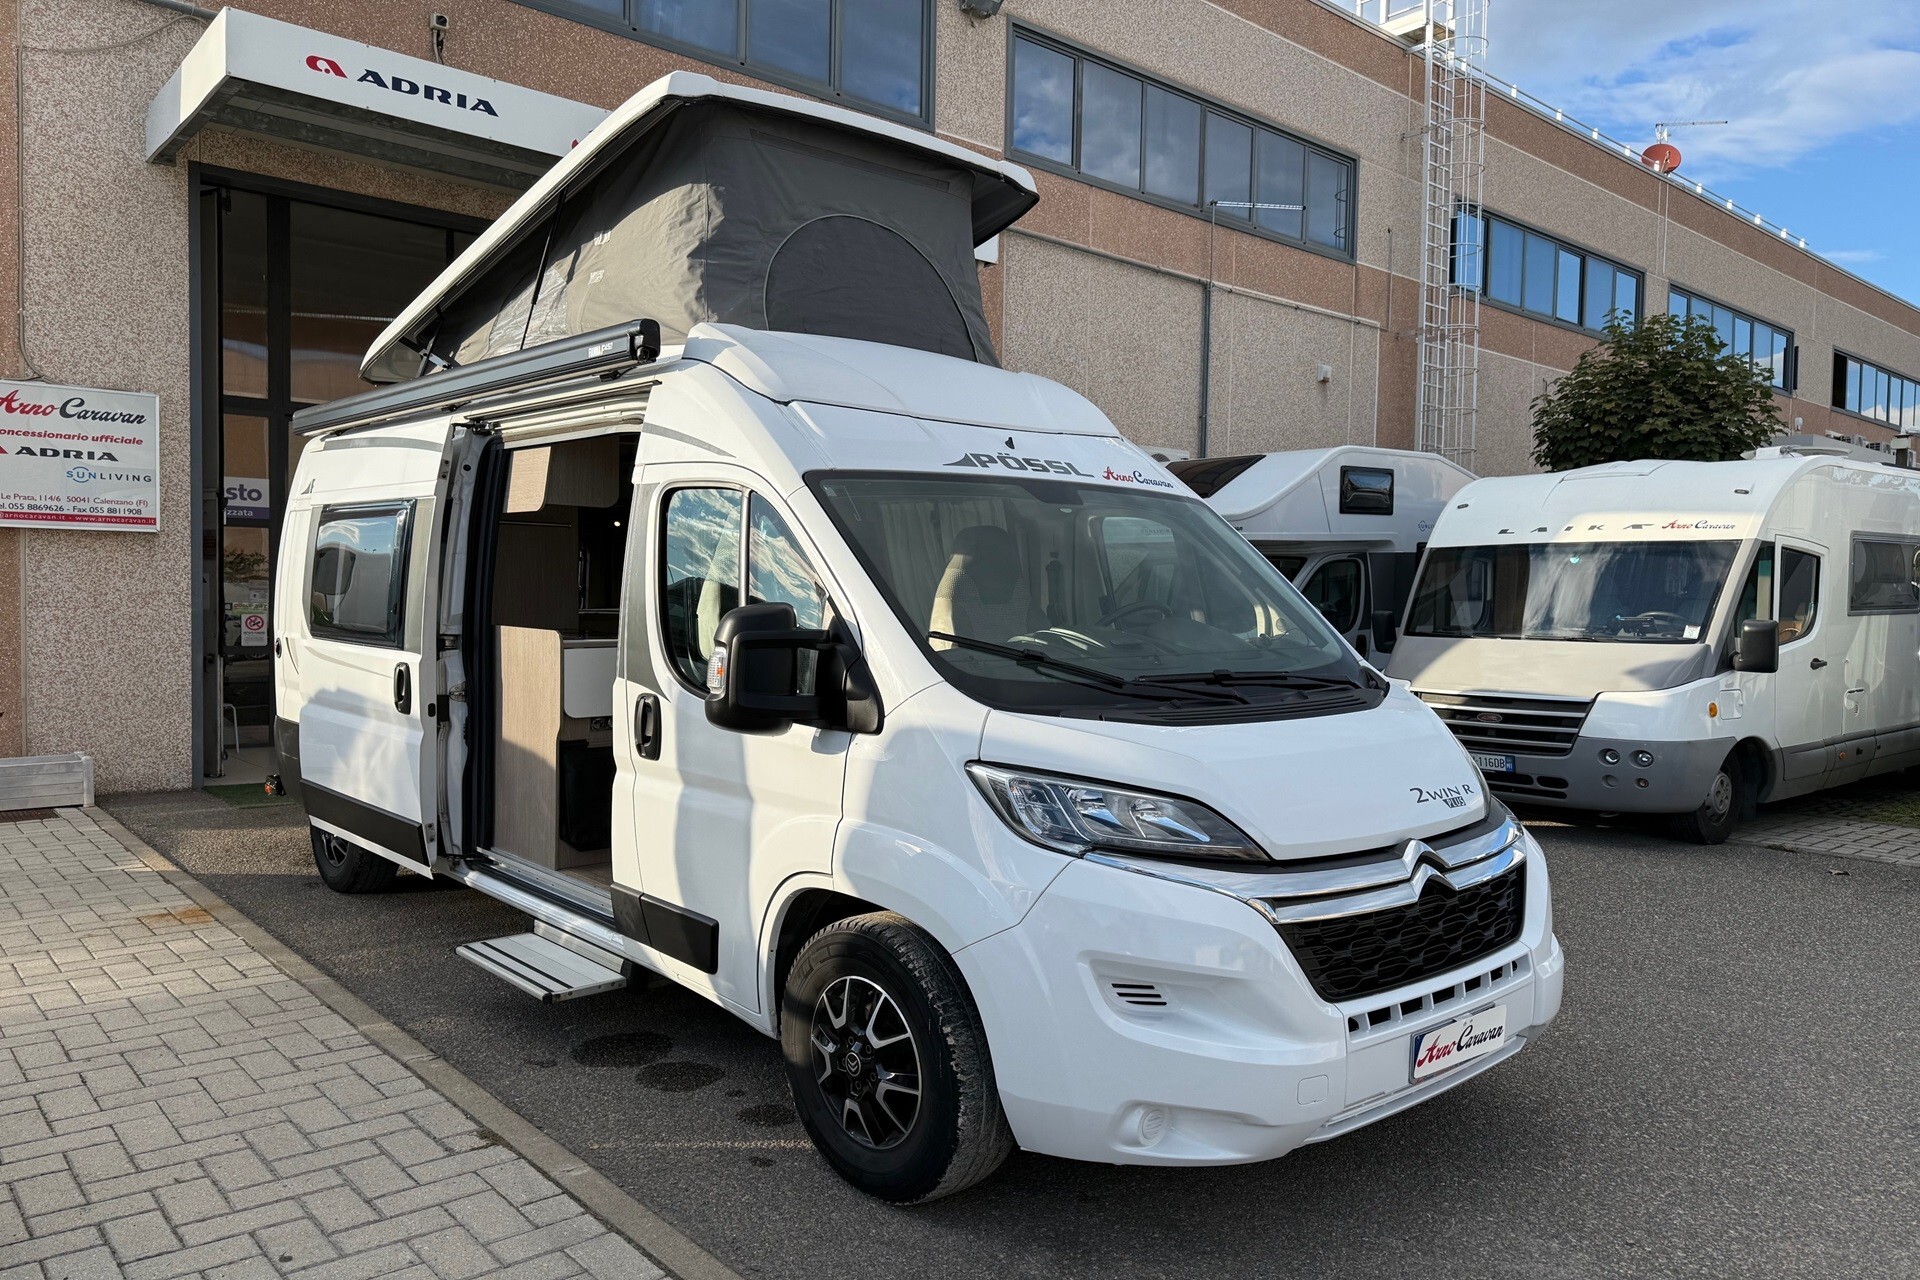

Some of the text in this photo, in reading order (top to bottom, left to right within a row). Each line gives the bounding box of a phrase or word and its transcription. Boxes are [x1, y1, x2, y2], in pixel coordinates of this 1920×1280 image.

[356, 68, 499, 117] ADRIA
[0, 389, 147, 425] Arno Caravan
[0, 429, 144, 445] oncessionario ufficiale
[15, 446, 119, 461] ADRIA
[975, 452, 1095, 478] PÖSSL
[66, 466, 152, 483] SUNLIVING
[13, 493, 37, 501] Prata,
[93, 497, 134, 506] Calenzano
[225, 483, 263, 501] sto
[0, 512, 66, 520] @arnocaravan.it
[27, 504, 65, 512] 8869626
[106, 507, 142, 515] 8811908
[1661, 519, 1693, 529] Arno
[1462, 784, 1475, 794] R
[1417, 1024, 1503, 1067] Arno Caravan
